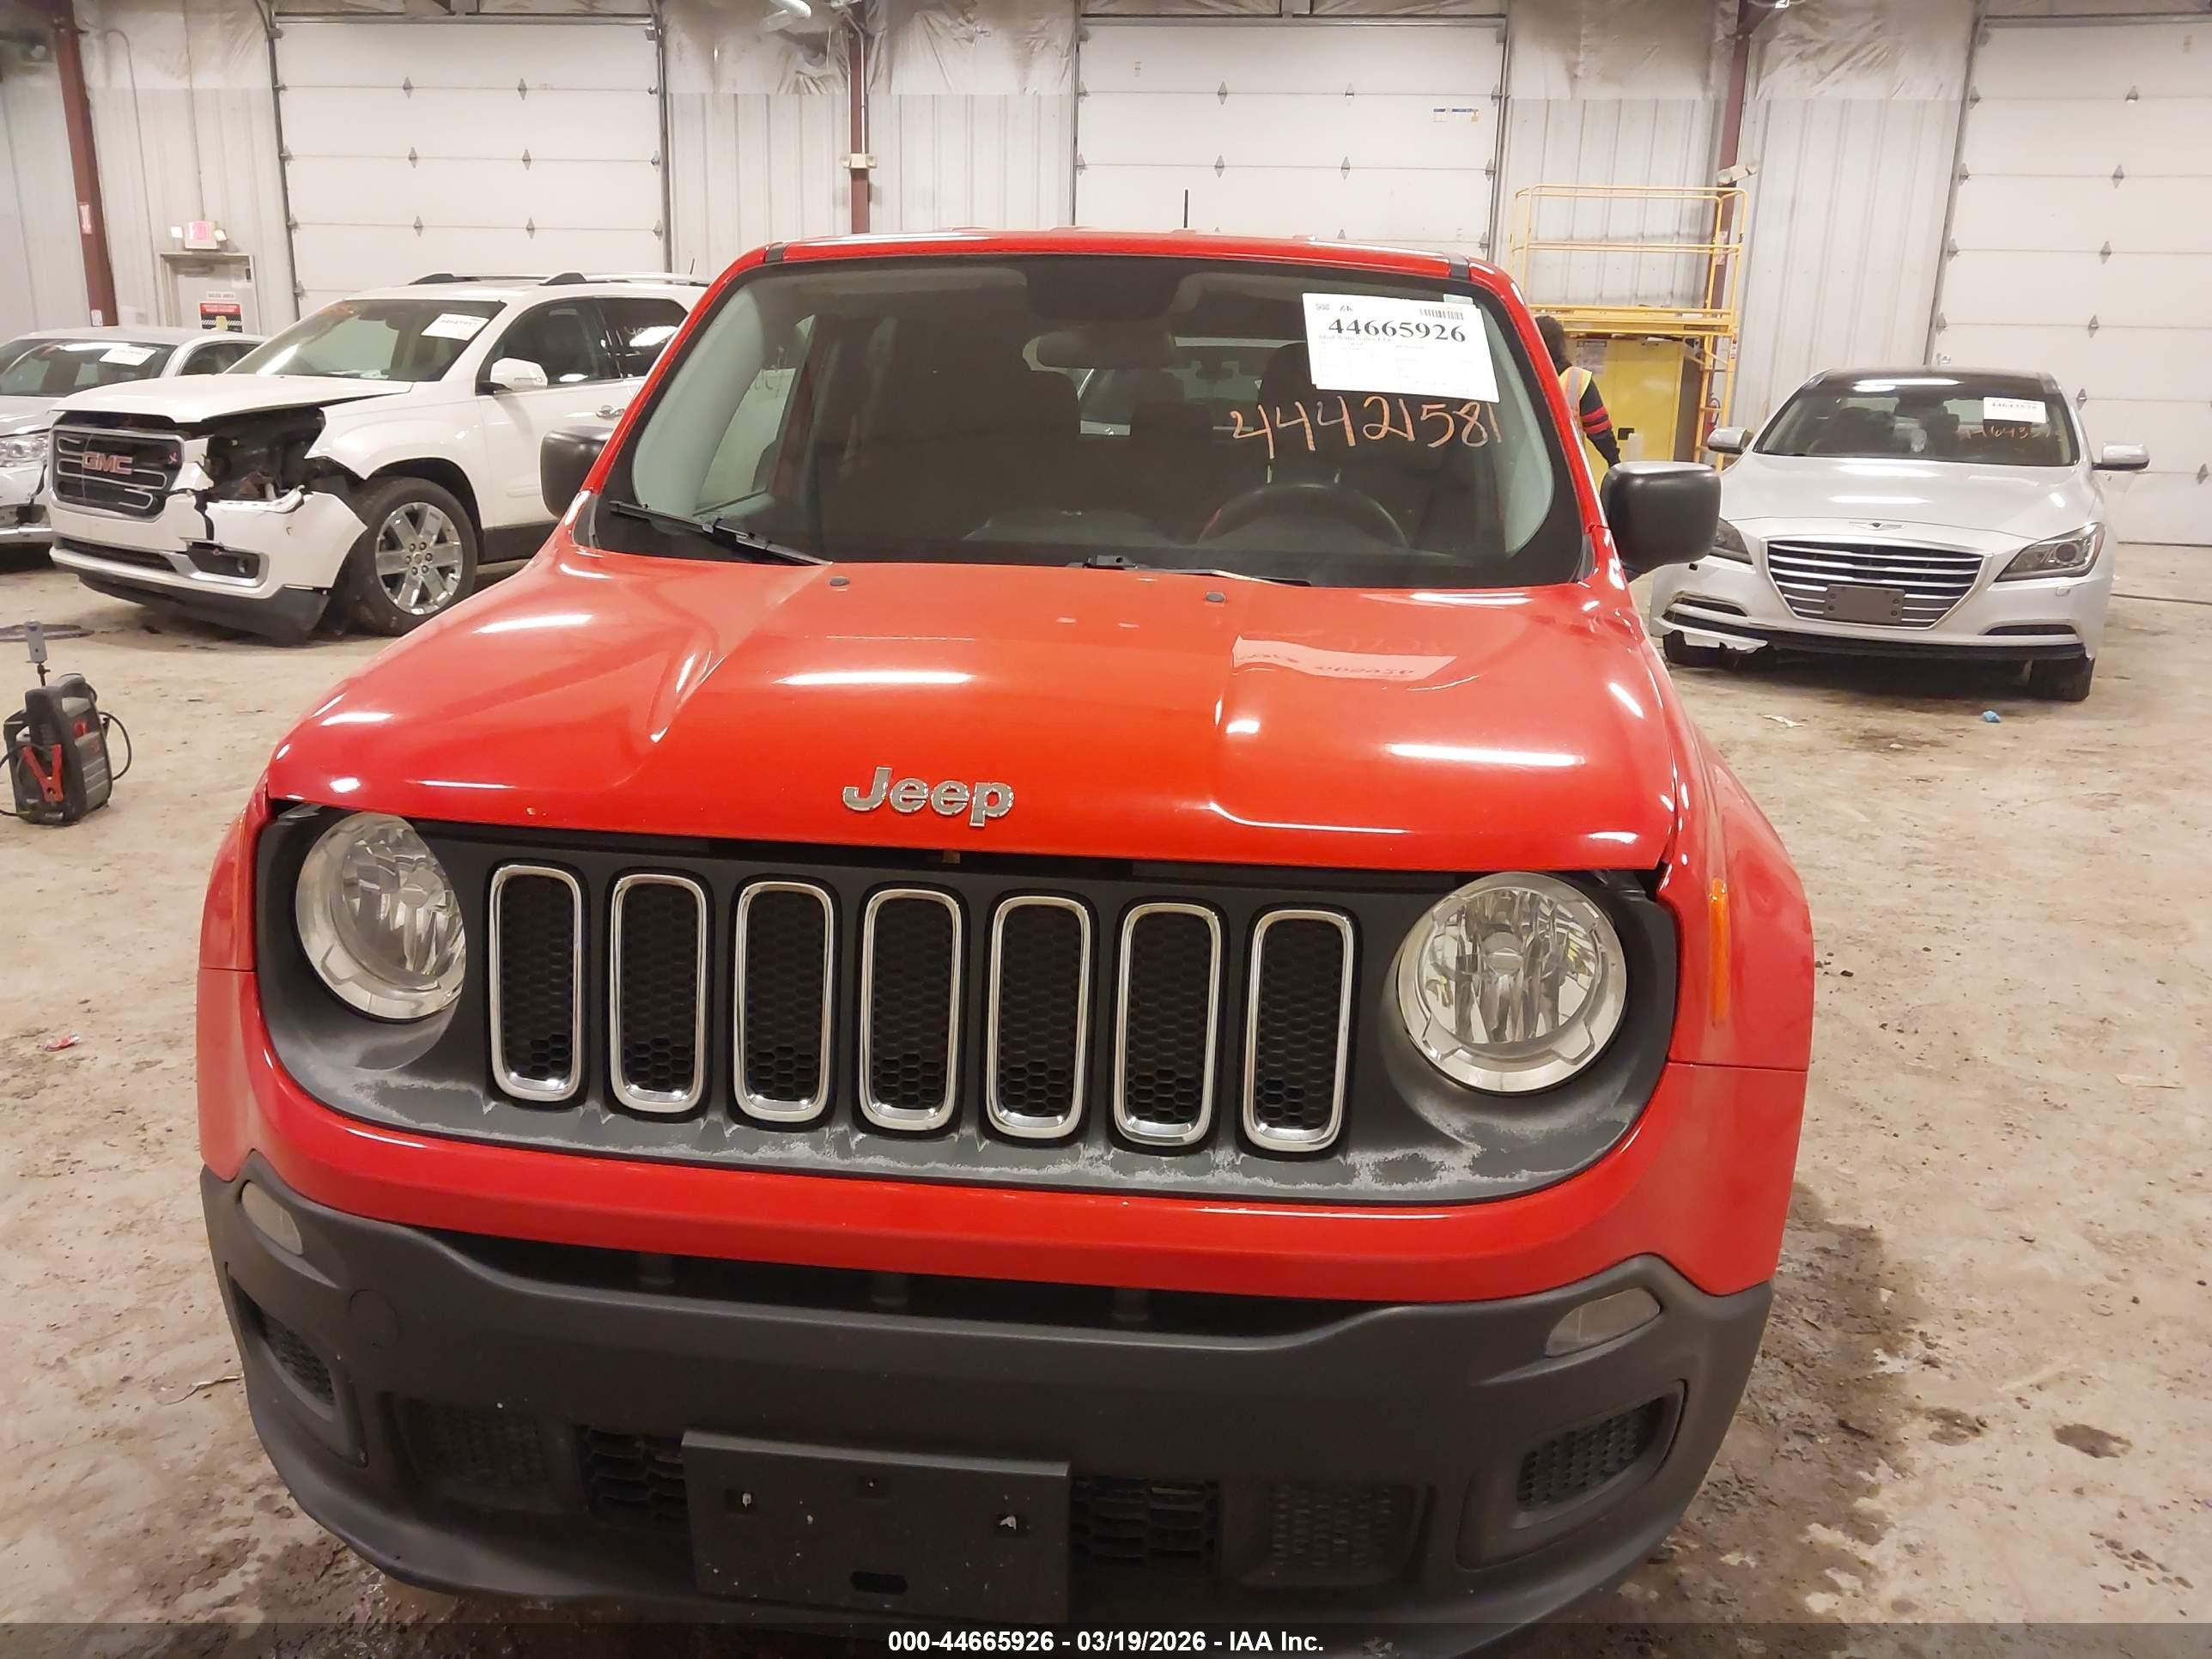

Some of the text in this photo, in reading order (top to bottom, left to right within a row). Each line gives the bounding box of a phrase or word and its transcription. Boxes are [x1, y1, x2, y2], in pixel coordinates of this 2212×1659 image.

[1328, 318, 1467, 343] 44665926
[1231, 396, 1502, 459] 44421581
[82, 451, 133, 475] GMC
[842, 766, 1016, 827] Jeep
